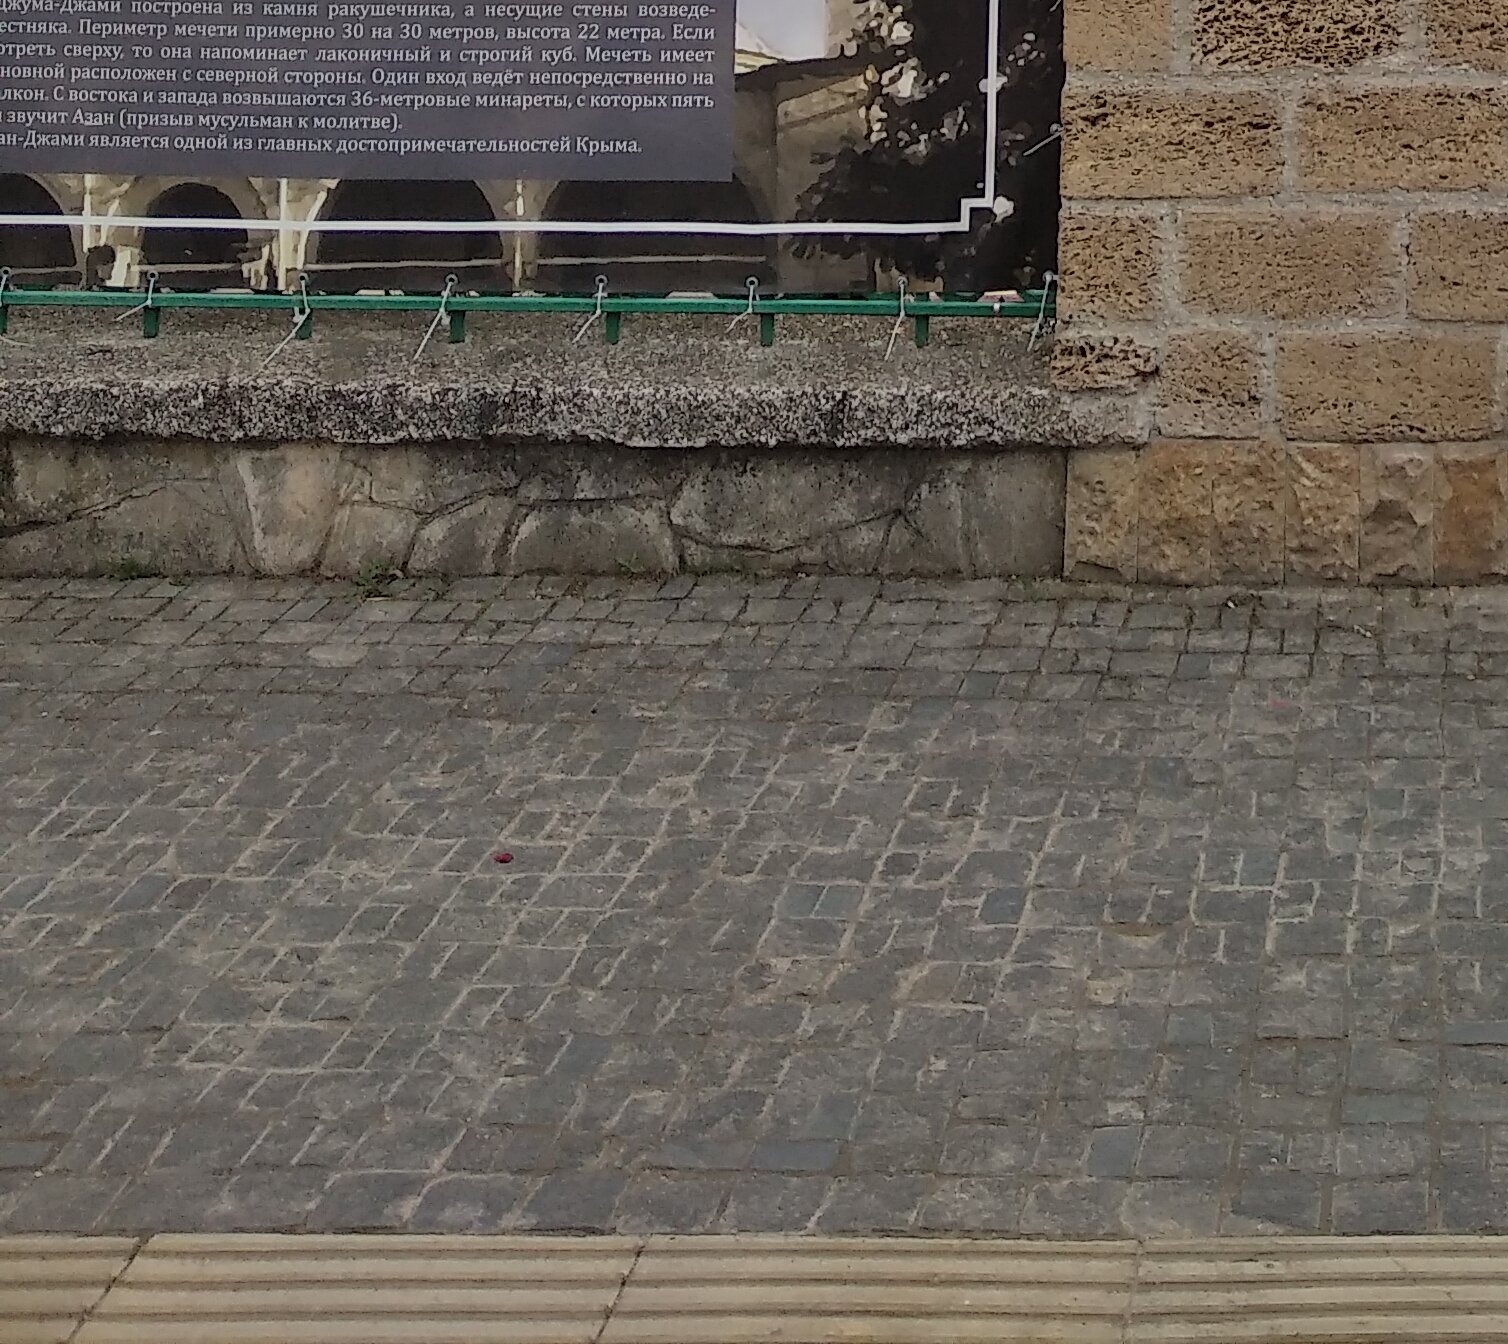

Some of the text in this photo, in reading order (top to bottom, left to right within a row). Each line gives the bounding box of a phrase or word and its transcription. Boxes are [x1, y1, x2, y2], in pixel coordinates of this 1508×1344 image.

[132, 1, 222, 18] построена
[263, 3, 318, 16] камня
[328, 4, 455, 21] ракушечника,
[485, 5, 563, 21] несущие
[573, 5, 627, 17] стены
[638, 5, 715, 20] возведе-
[79, 19, 714, 43] Периметр мечети примерно 30 30 метров, высота 22 метра. Если
[64, 44, 715, 66] сверху, она напоминает лаконичный строгий куб. Мечеть имеет
[71, 66, 686, 88] расположен северной стороны. Один вход ведёт непосредственно
[69, 90, 714, 111] востока запада возвышаются 36-метровые минареты, которых пять
[6, 108, 402, 133] звучит Азан (призыв мусульман молитве).
[89, 133, 642, 156] является одной главных достопримечательностей Крыма.
